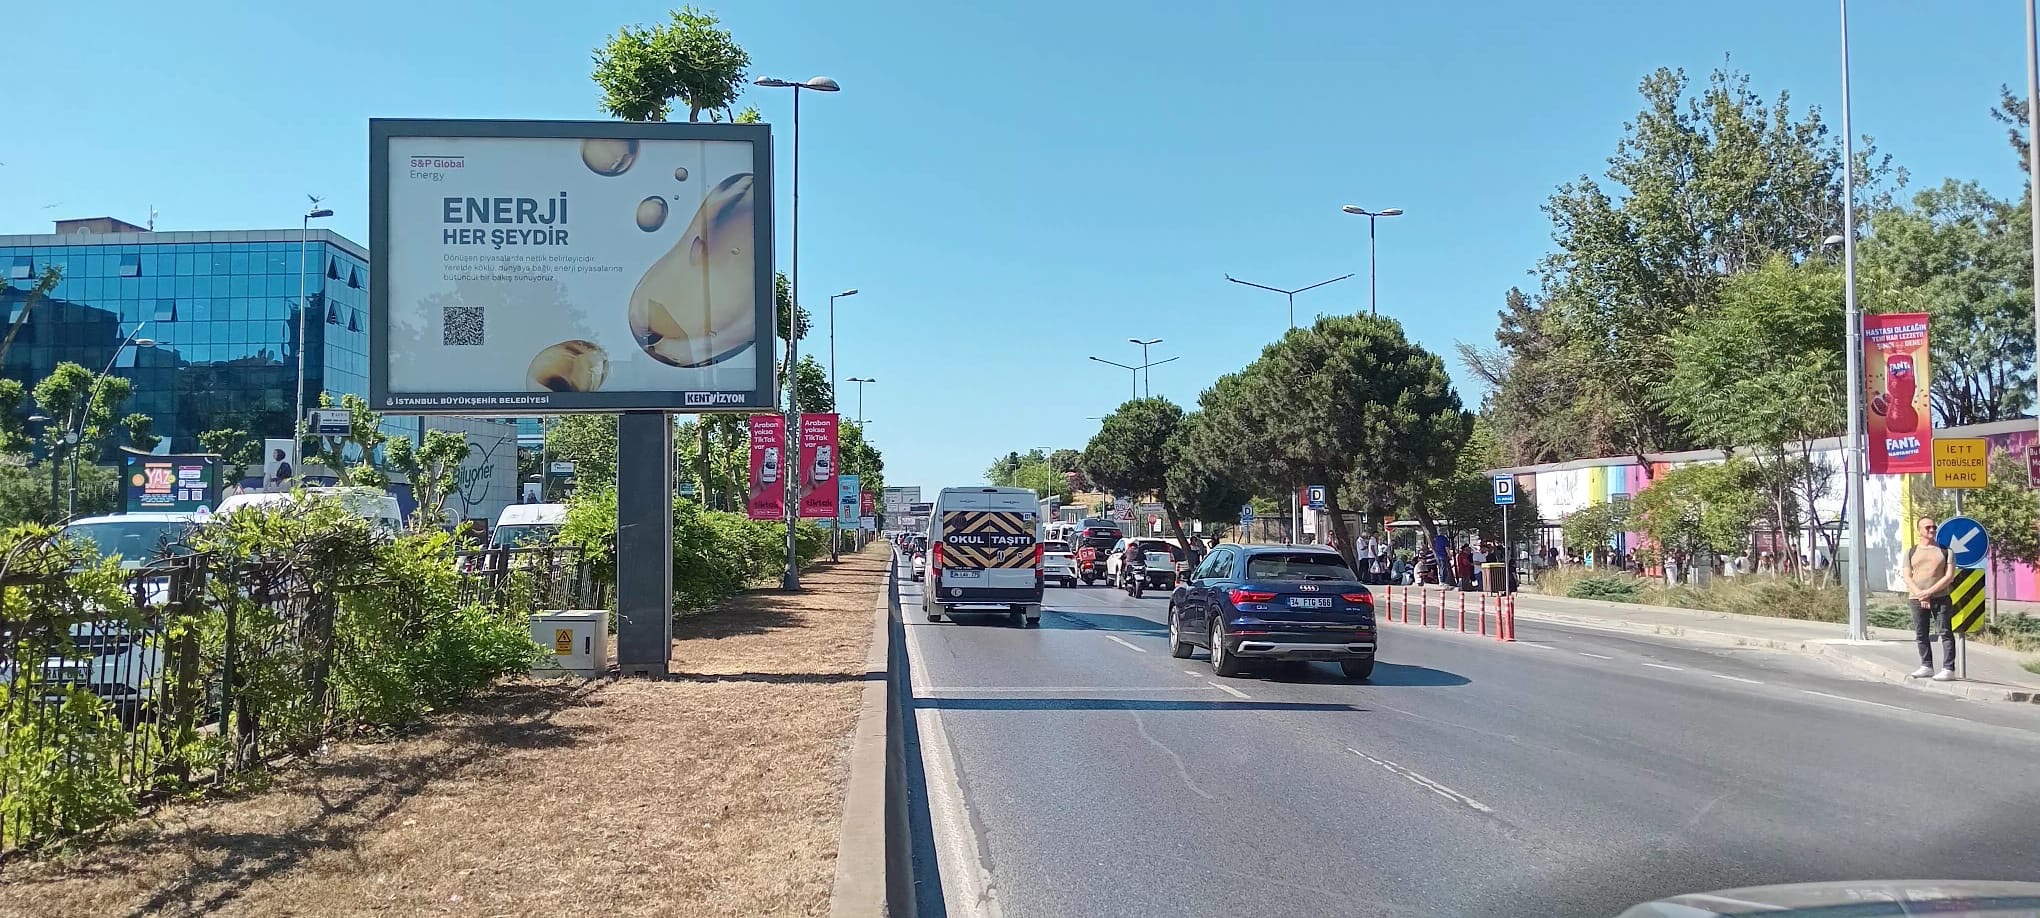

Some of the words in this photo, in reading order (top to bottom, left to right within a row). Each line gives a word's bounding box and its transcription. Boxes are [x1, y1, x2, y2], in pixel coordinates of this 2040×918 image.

[410, 160, 431, 168] S&P
[434, 160, 464, 168] Global
[410, 170, 444, 181] Energy
[444, 192, 567, 224] ENERJİ
[444, 229, 485, 244] HER
[491, 226, 568, 250] ŞEYDİR
[1866, 328, 1893, 336] HASTASI
[396, 397, 438, 405] İSTANBUL
[440, 396, 497, 405] BÜYÜKŞEHİR
[499, 396, 549, 404] BELEDİYESİ
[686, 392, 744, 404] KENTVİZYON
[1885, 437, 1920, 450] FANTA
[1947, 444, 1972, 453] İETT
[1937, 458, 1984, 466] OTOBÜSLERİ
[1946, 472, 1976, 482] HARİÇ
[1499, 482, 1509, 493] D
[1313, 490, 1321, 500] D
[991, 536, 1030, 545] TAŞITI
